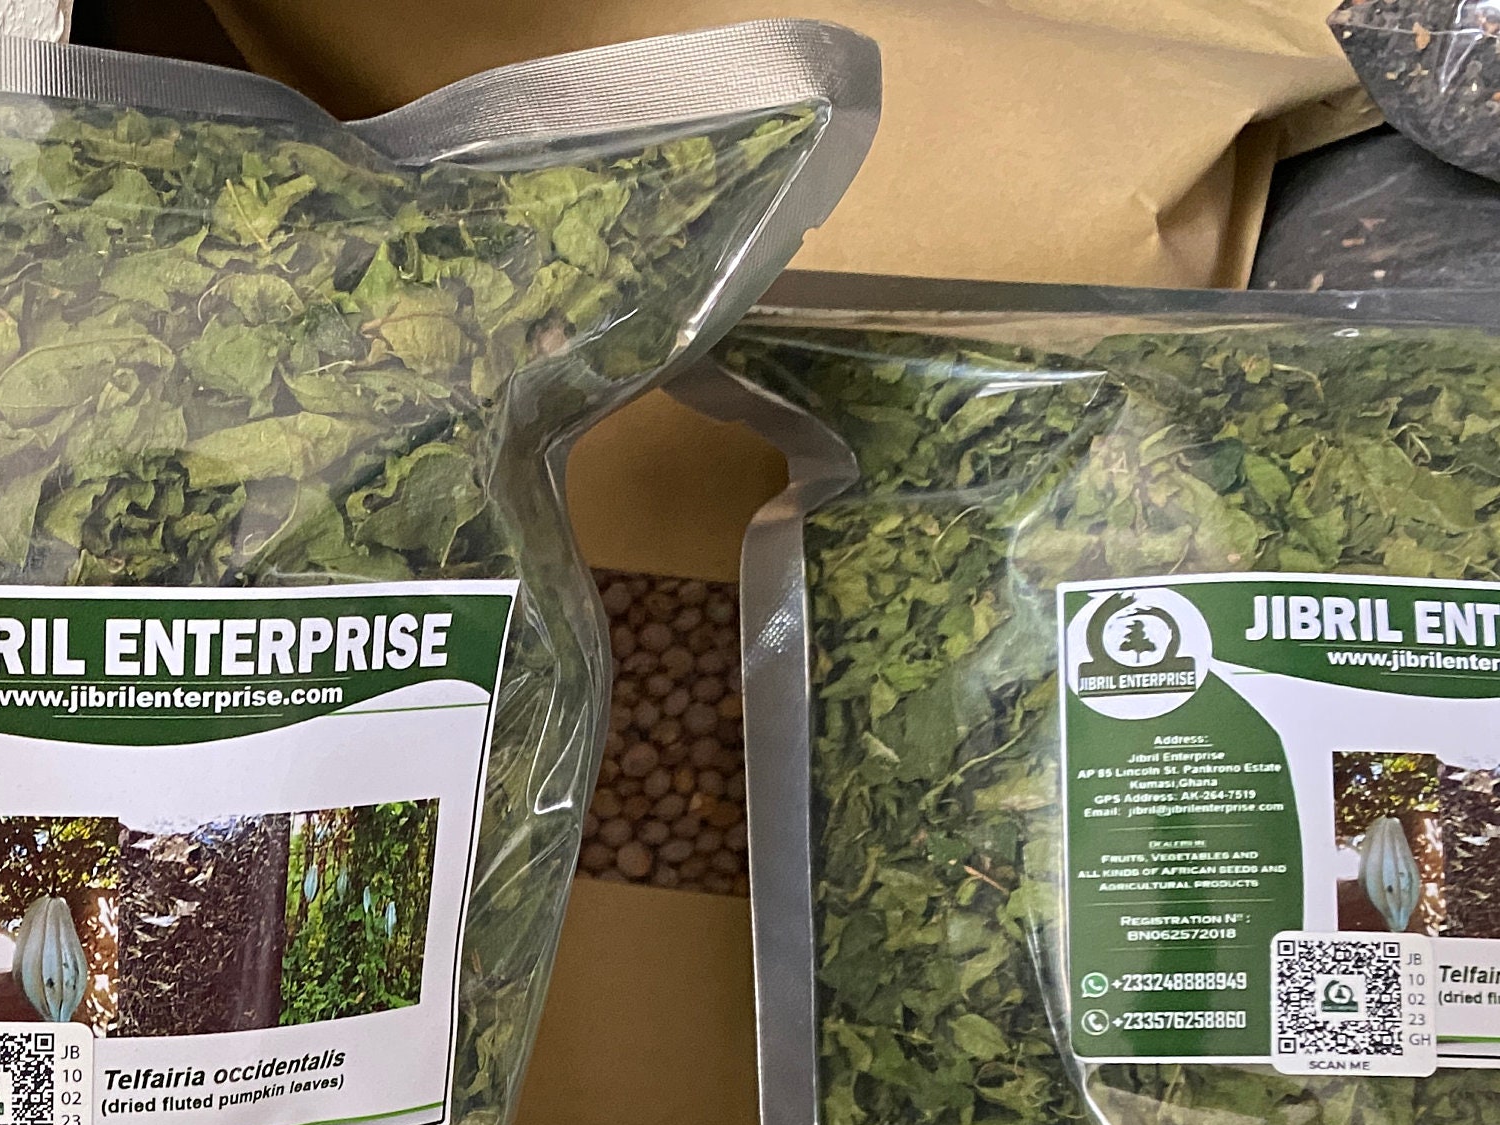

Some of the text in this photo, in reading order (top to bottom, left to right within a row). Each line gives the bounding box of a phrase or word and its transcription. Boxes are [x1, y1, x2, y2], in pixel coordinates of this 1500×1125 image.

[1245, 595, 1500, 647] JIBRIL ENT
[105, 612, 453, 677] ENTERPRISE
[1079, 671, 1195, 691] JIBRIL ENTERPRISE
[1153, 735, 1209, 745] Address:
[1127, 751, 1225, 763] Jibril Enterprise
[1077, 769, 1095, 779] AP
[1115, 766, 1160, 777] Lincoln
[1244, 763, 1282, 773] Estate
[1094, 794, 1120, 804] GPS
[1084, 807, 1120, 817] Email:
[1127, 928, 1237, 941] BN062572018
[1406, 953, 1423, 966] JB
[1111, 972, 1247, 992] +233248888949
[1409, 973, 1425, 986] 10
[1408, 993, 1425, 1006] 02
[1438, 991, 1482, 1006] (dried
[1112, 1010, 1246, 1030] +233576258860
[1408, 1013, 1425, 1026] 23
[1408, 1033, 1431, 1046] GH
[61, 1045, 80, 1060] JB
[104, 1049, 346, 1091] Telfairia occidentalis
[1309, 1060, 1370, 1071] SCAN ME
[62, 1068, 82, 1083] 10
[61, 1091, 82, 1106] 02
[101, 1074, 345, 1117] (dried fluted pumpkin leaves)
